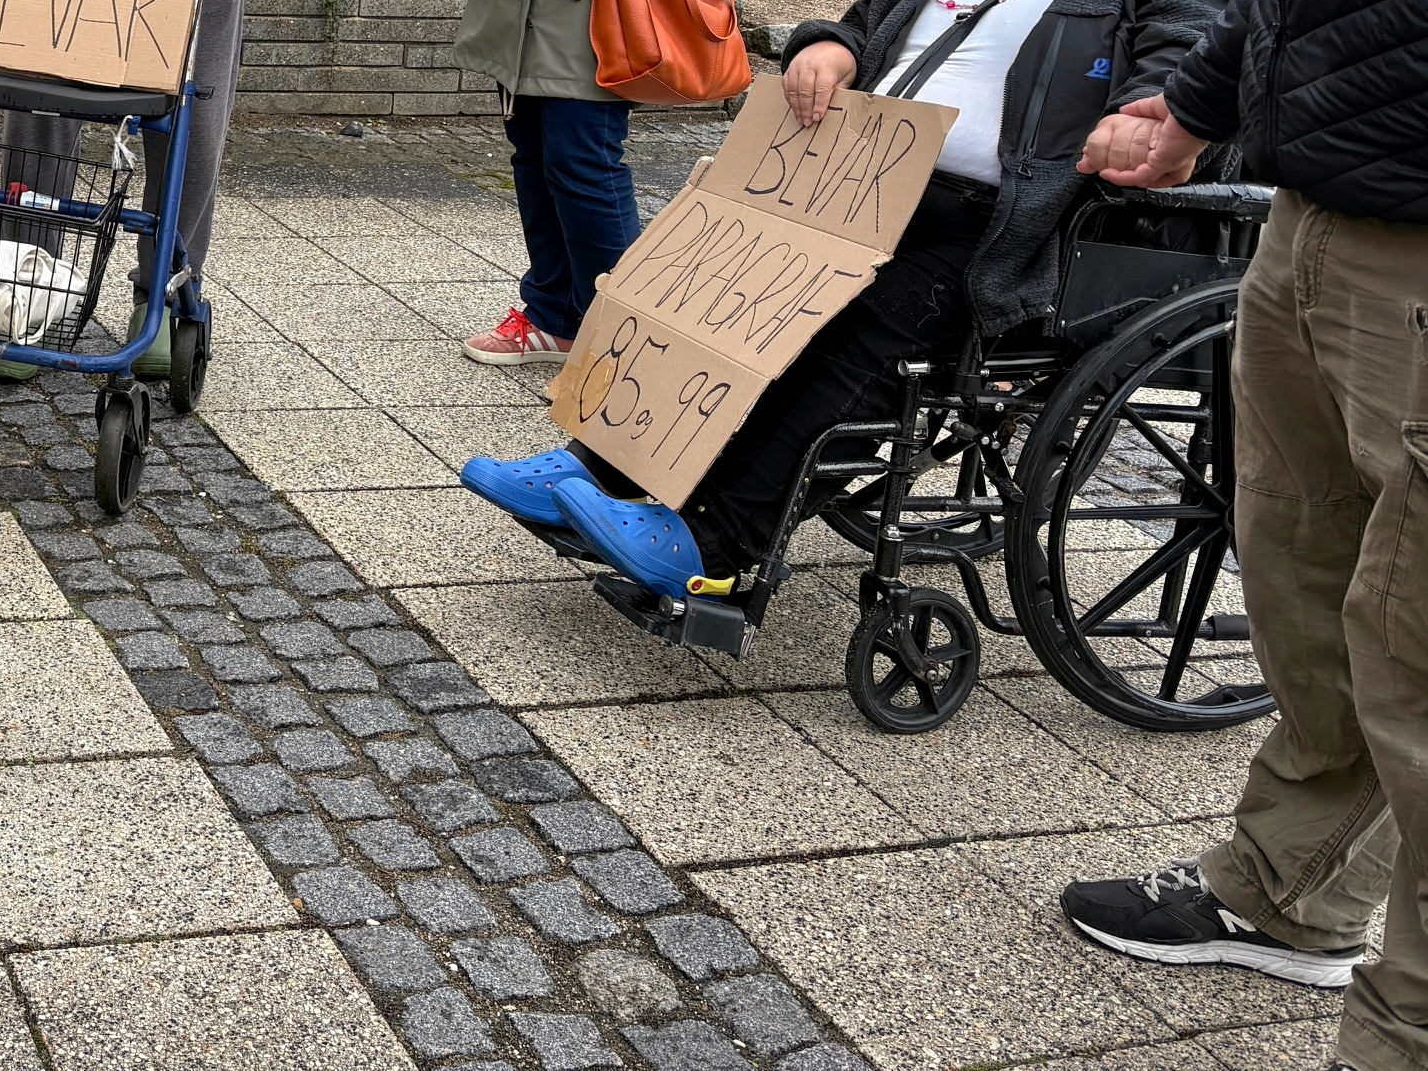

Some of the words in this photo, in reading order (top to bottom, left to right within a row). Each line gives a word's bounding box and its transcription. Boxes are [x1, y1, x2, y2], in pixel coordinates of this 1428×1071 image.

[743, 106, 916, 234] BEVAR
[616, 201, 863, 355] PARAGRAF
[578, 315, 670, 428] 85
[650, 370, 732, 471] 99
